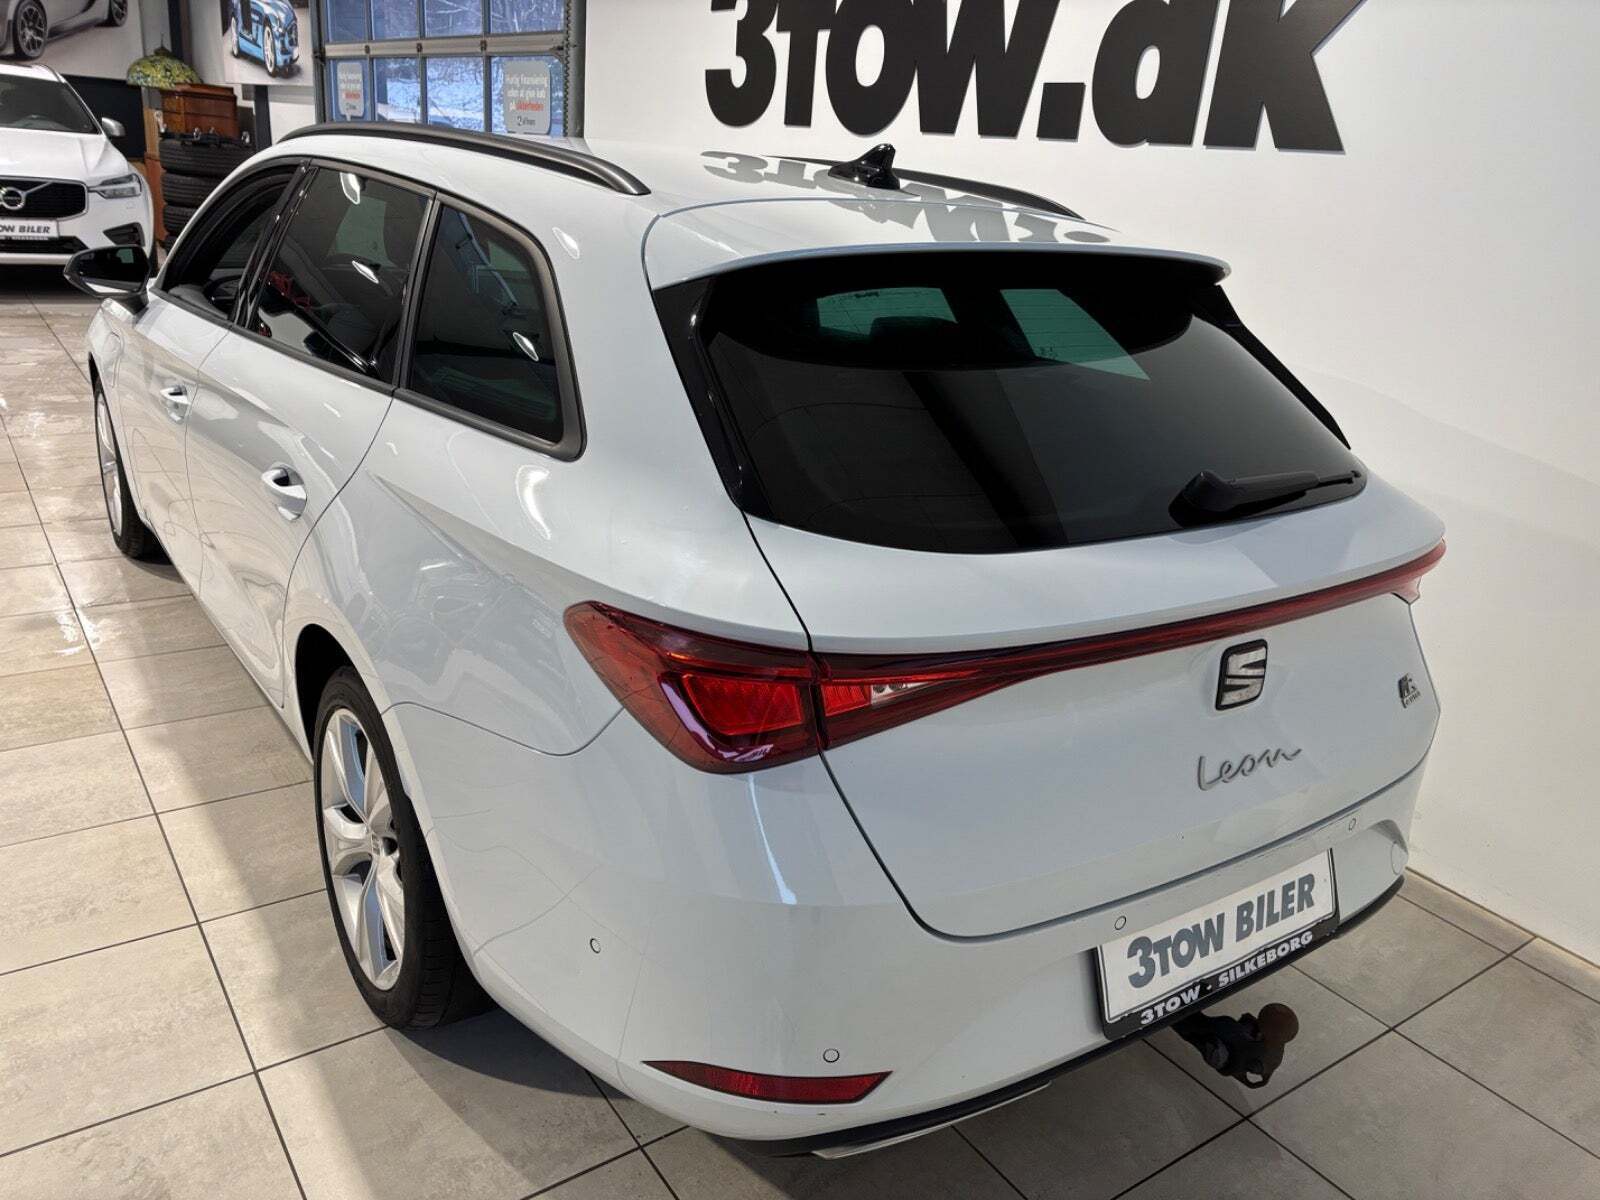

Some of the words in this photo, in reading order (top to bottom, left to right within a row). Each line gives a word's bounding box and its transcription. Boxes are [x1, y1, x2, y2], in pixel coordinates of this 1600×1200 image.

[19, 225, 50, 233] BILER
[1197, 748, 1303, 791] Leon
[1127, 912, 1225, 988] 3TOW
[1236, 873, 1315, 942] BILER
[1141, 985, 1201, 1025] 3TOW
[1218, 930, 1313, 988] SILKEBORG
